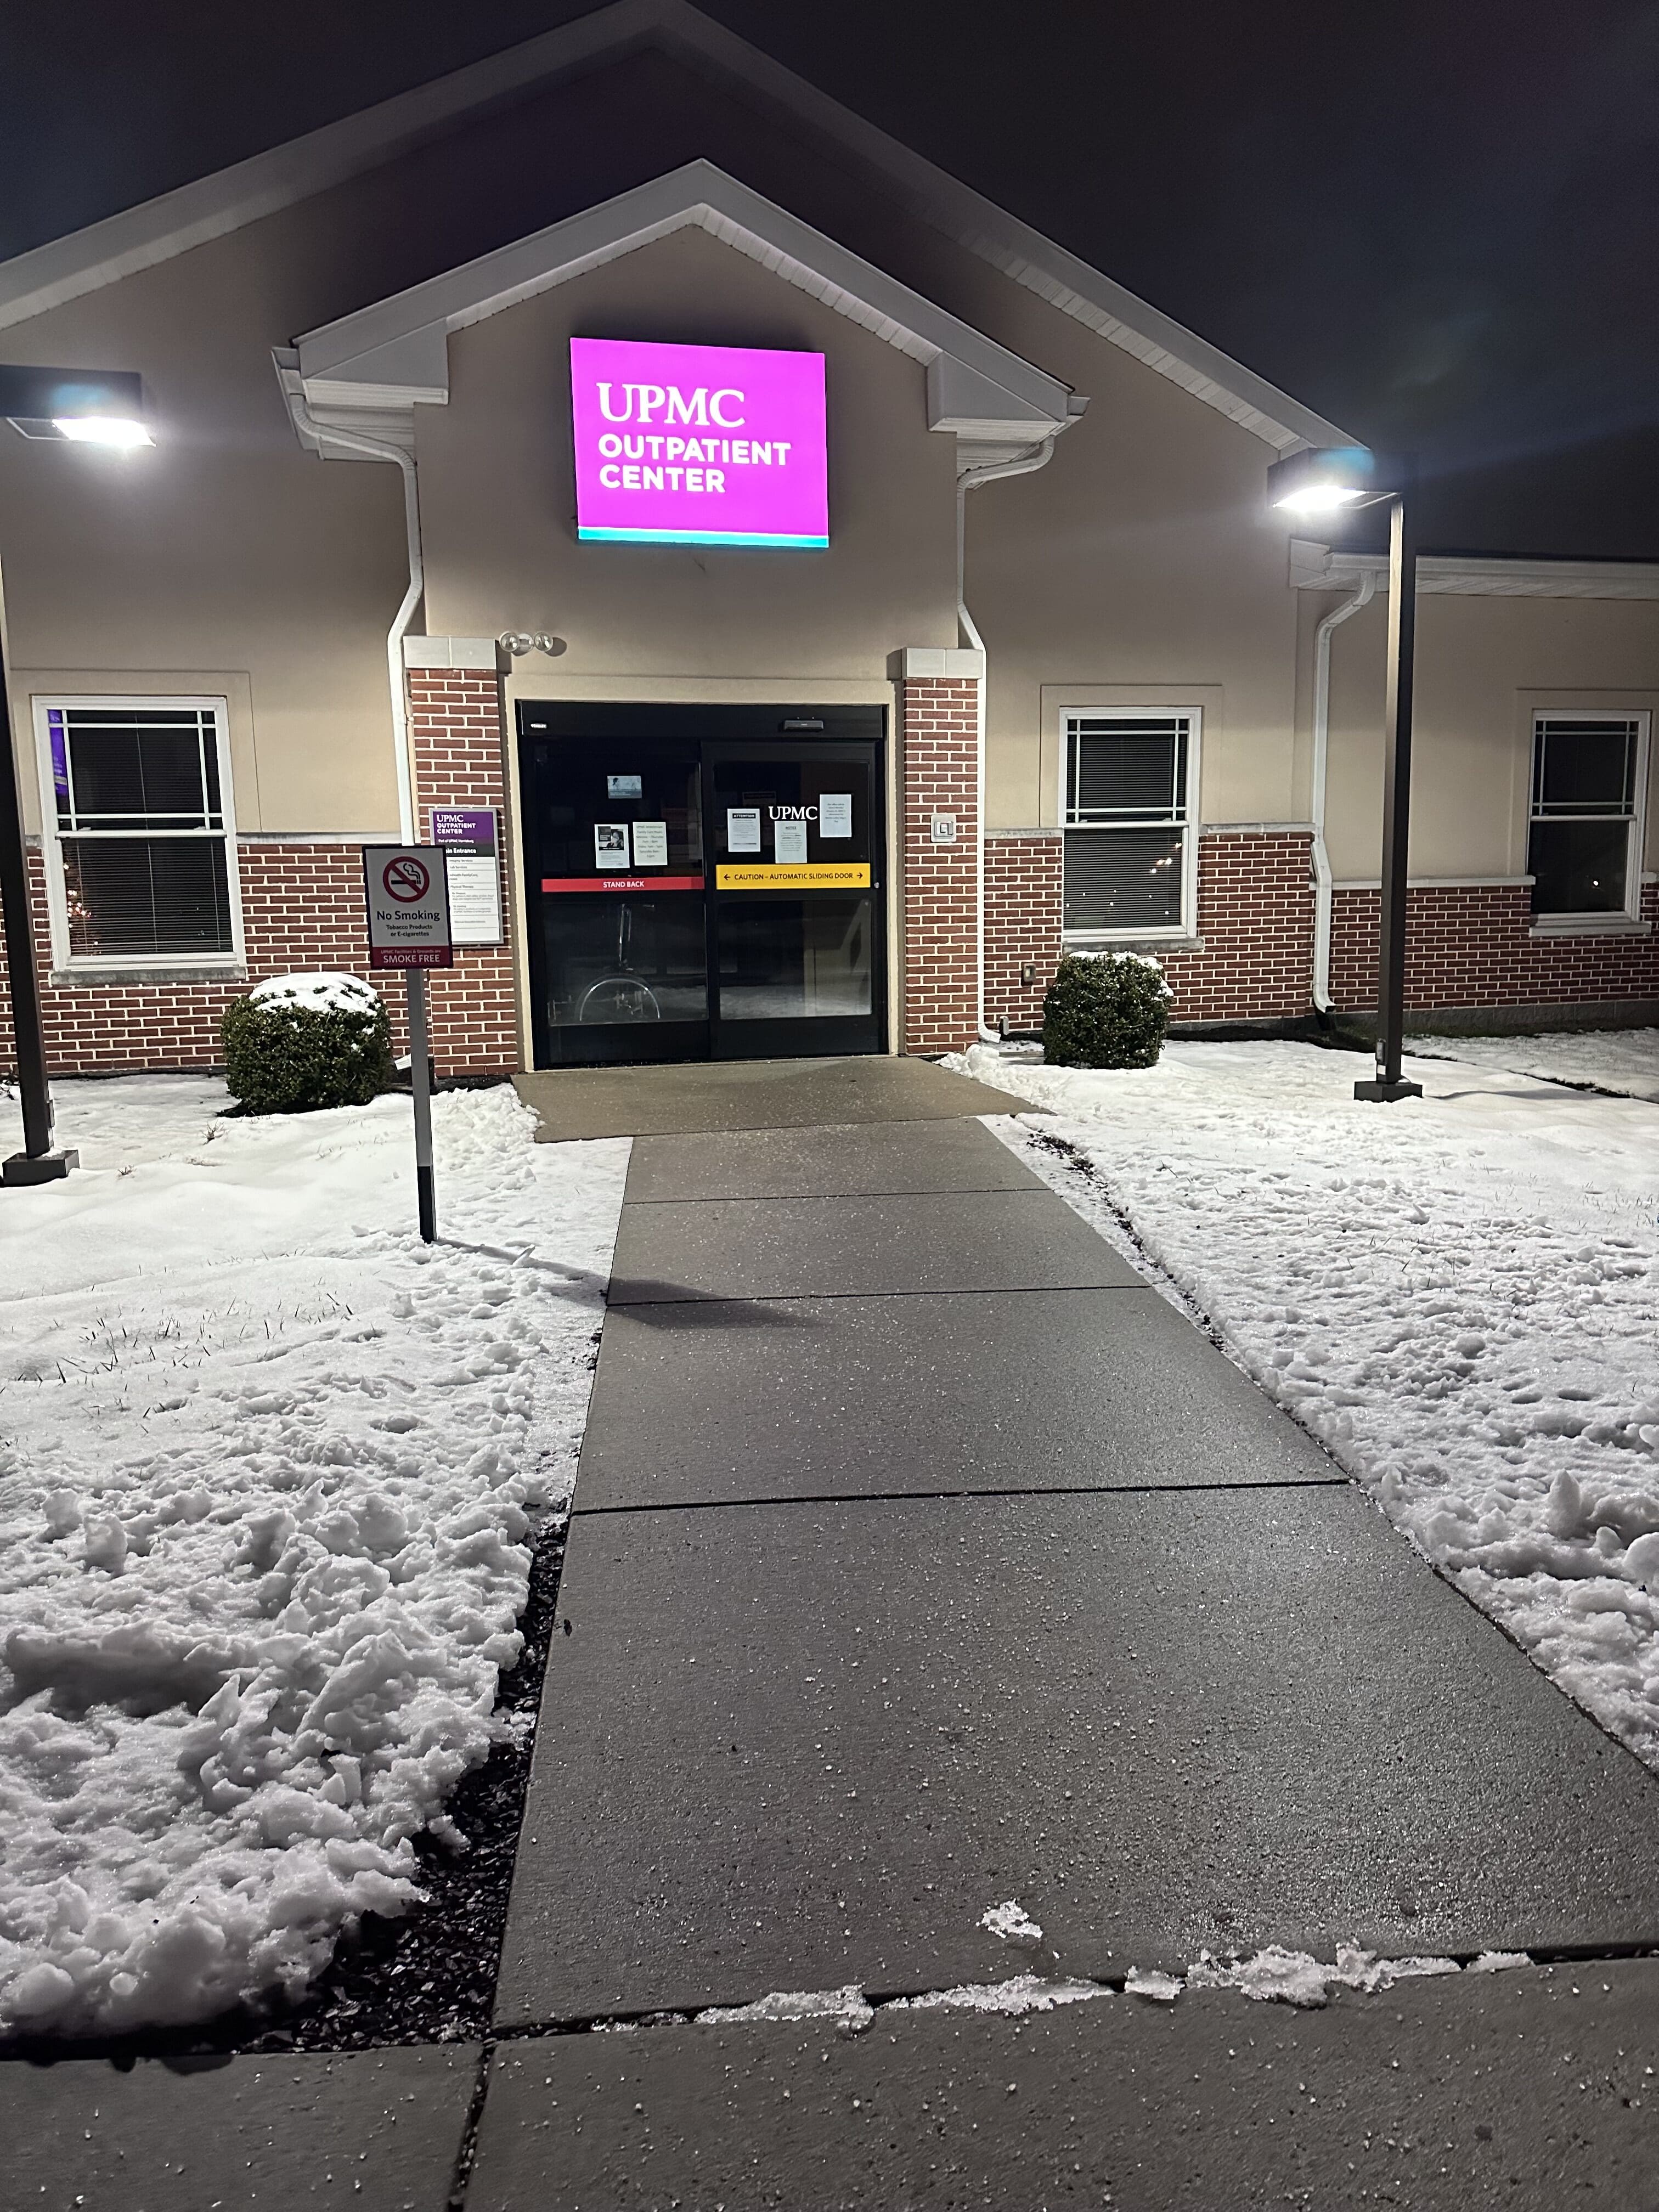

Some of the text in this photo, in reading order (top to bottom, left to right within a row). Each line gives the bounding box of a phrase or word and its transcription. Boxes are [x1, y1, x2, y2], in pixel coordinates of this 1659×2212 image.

[596, 382, 745, 428] UPMC
[598, 433, 791, 466] OUTPATIENT
[600, 464, 725, 493] CENTER
[768, 806, 817, 820] UPMC
[377, 910, 440, 922] No Smoking
[383, 954, 440, 963] SMOKE FREE
